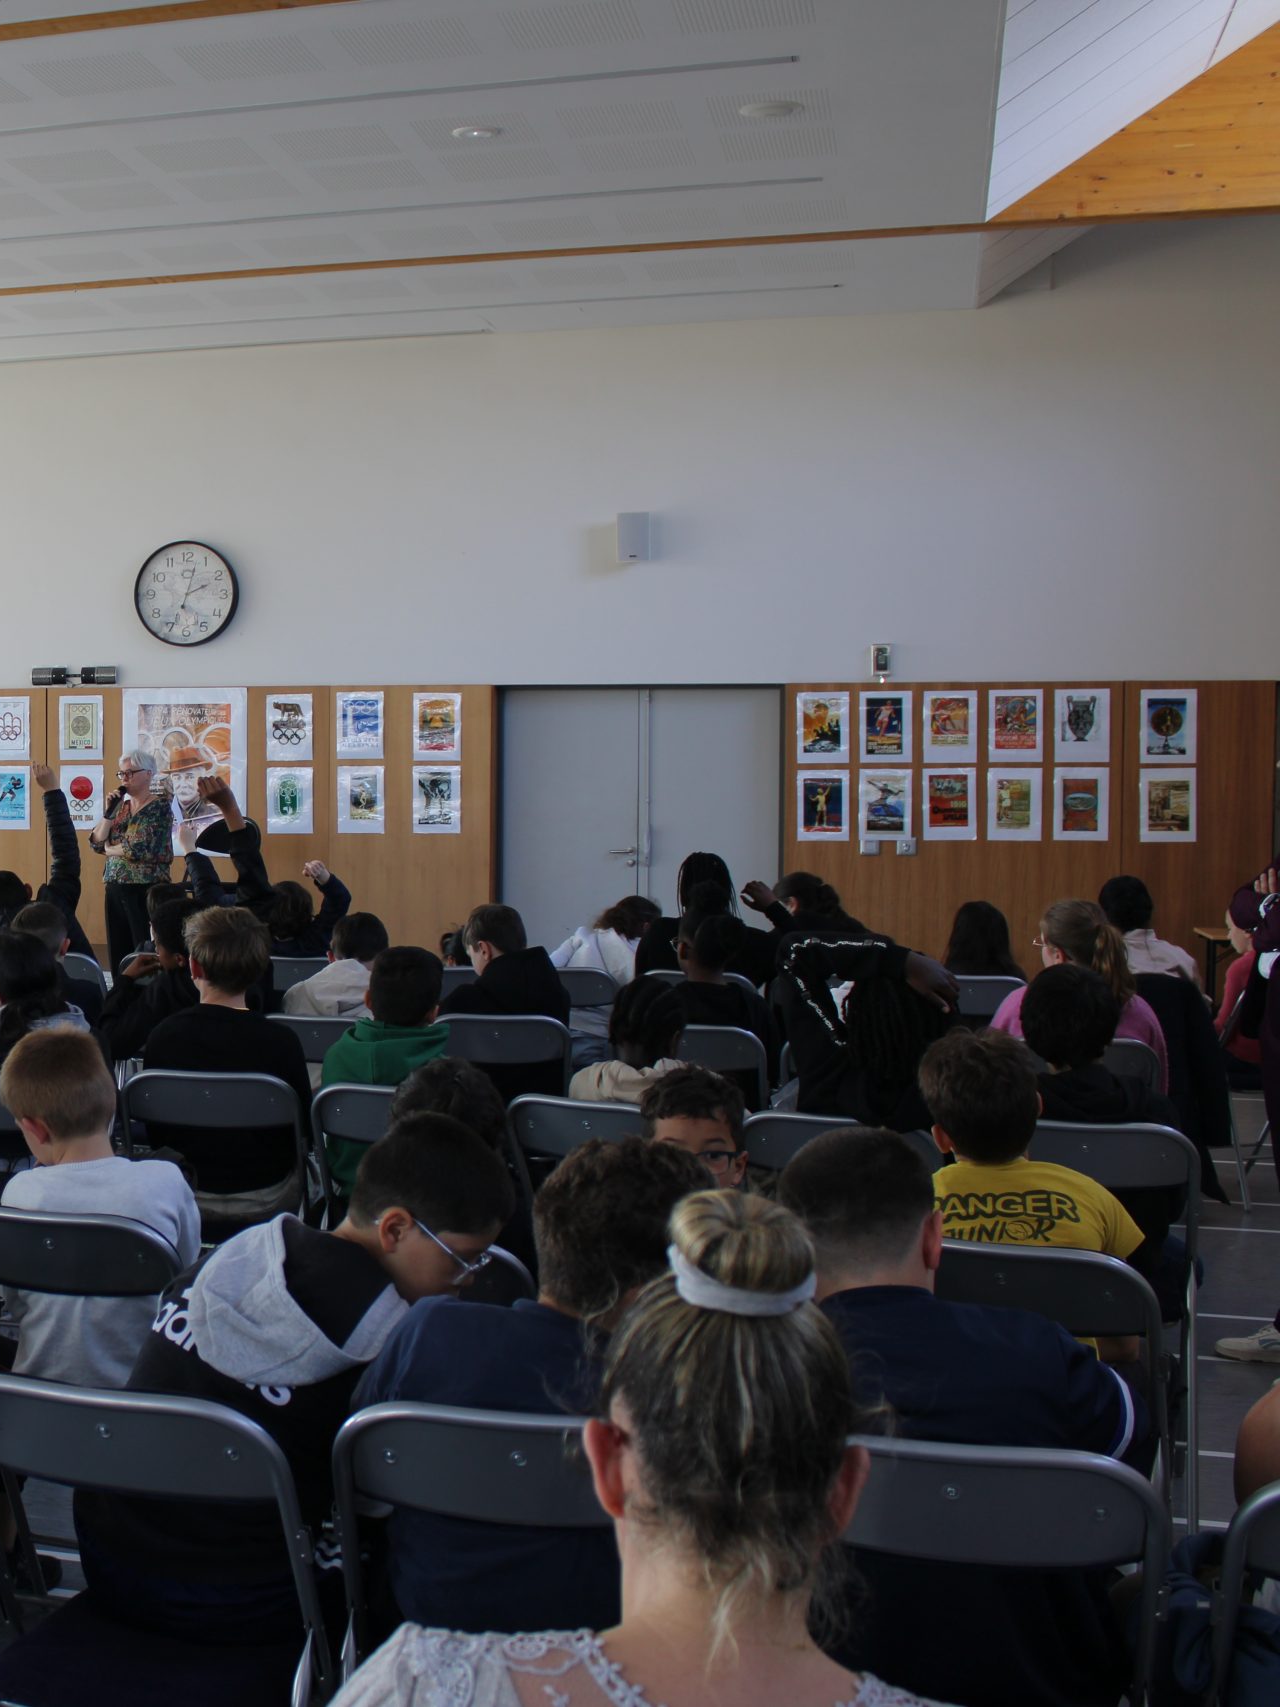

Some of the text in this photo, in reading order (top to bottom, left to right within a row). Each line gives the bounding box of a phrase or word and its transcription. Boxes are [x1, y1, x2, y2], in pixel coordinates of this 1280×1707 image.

[166, 557, 174, 568] 11
[182, 552, 194, 563] 12
[153, 572, 166, 582] 10
[214, 570, 223, 581] 2
[146, 589, 156, 600] 9
[219, 589, 229, 599] 3
[152, 608, 161, 618] 8
[213, 608, 222, 618] 4
[166, 622, 175, 632] 7
[182, 626, 191, 637] 6
[199, 622, 208, 632] 5
